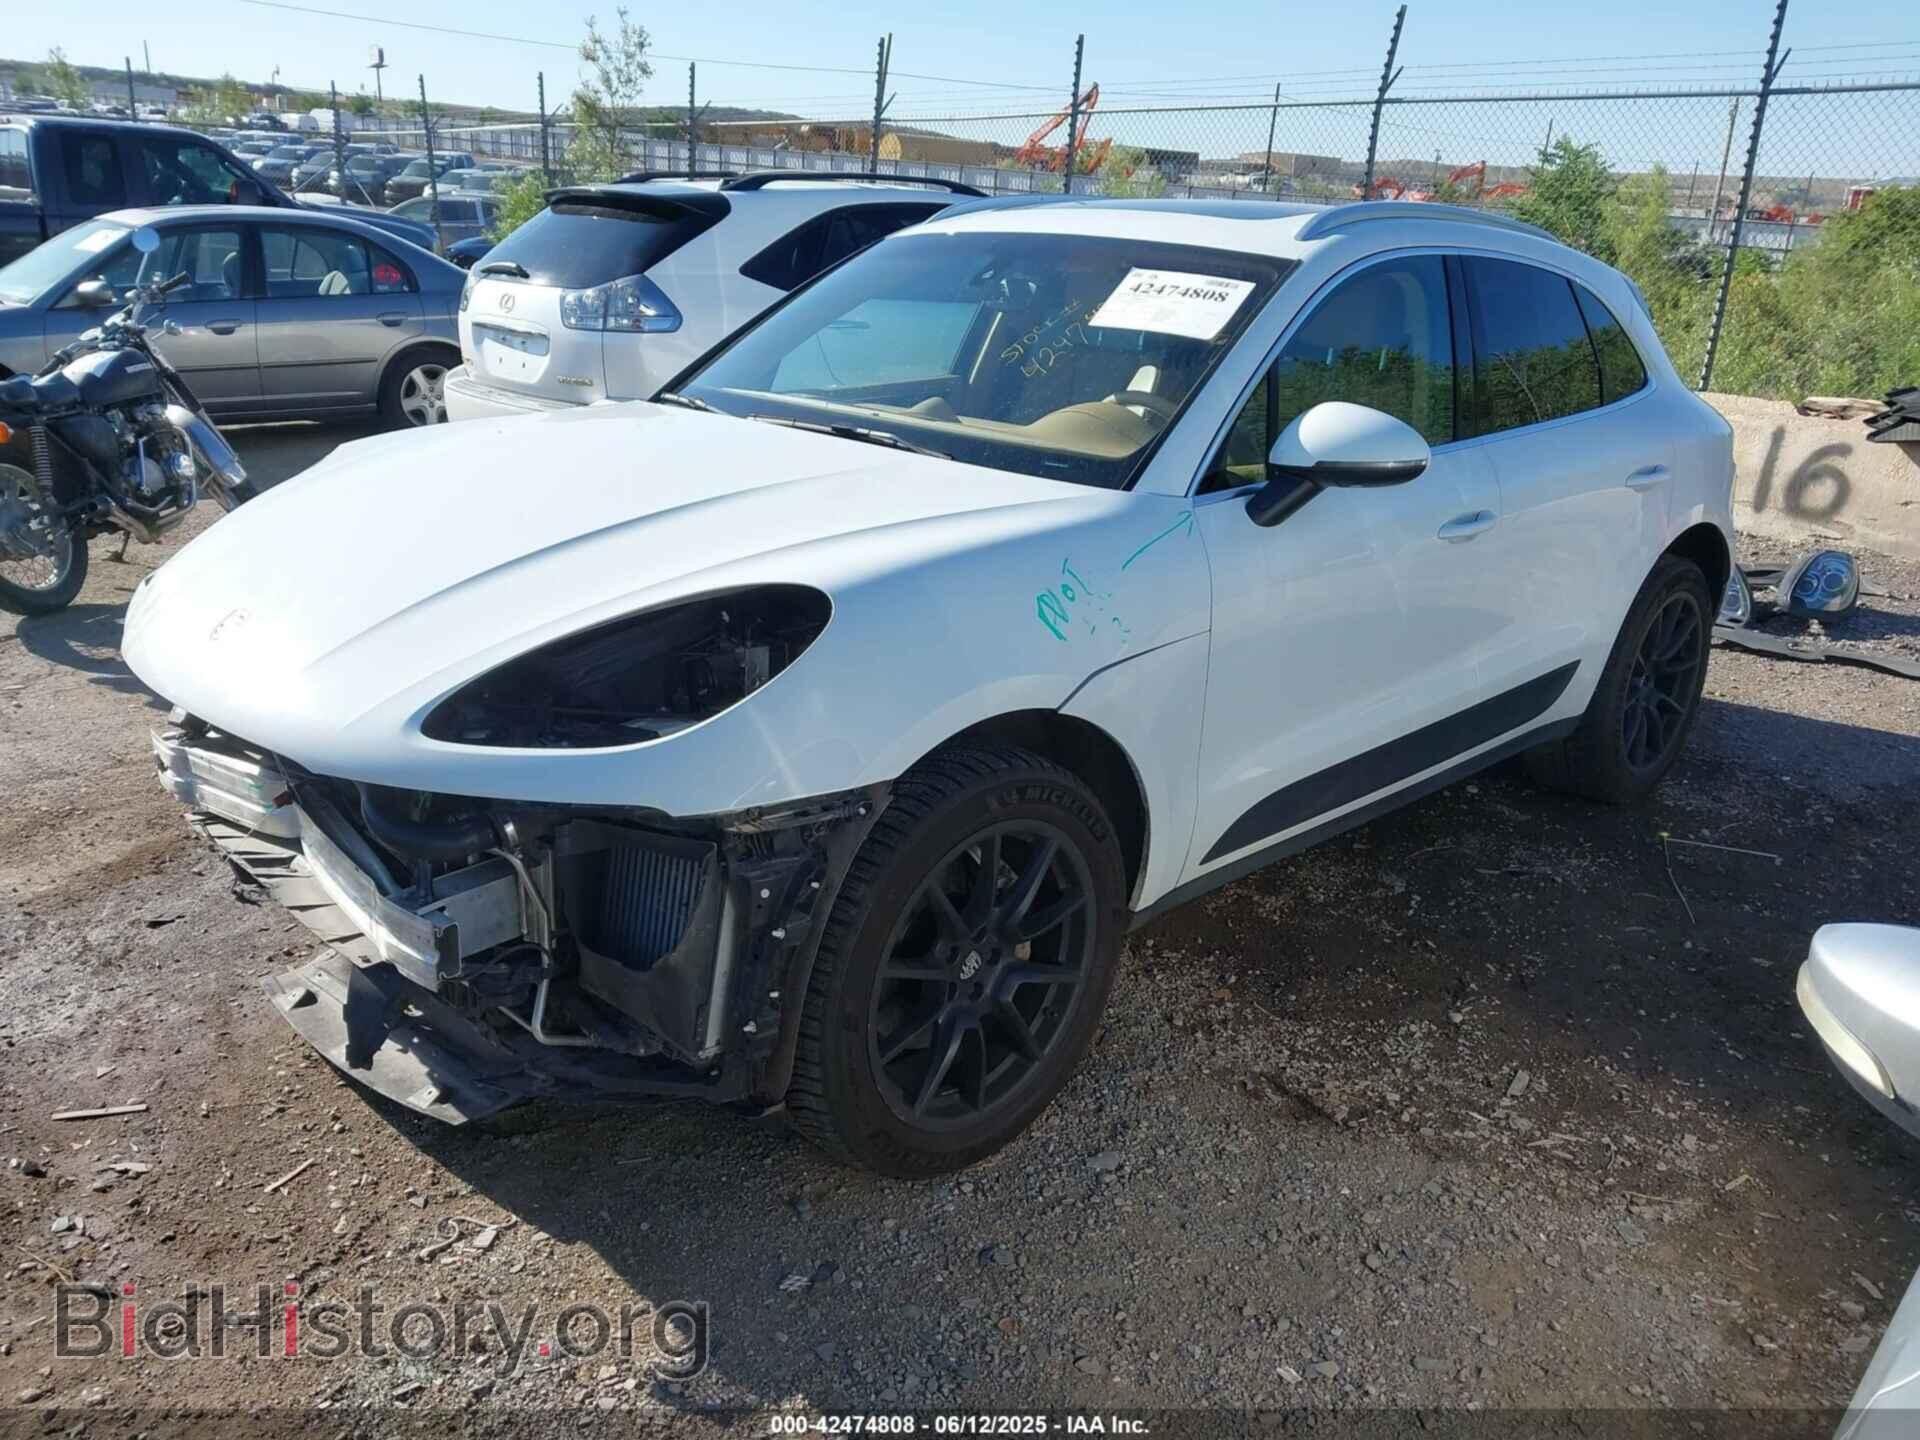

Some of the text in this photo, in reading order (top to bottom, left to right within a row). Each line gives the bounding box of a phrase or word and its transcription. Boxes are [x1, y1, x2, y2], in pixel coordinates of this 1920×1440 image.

[1129, 281, 1230, 303] 42474808
[1753, 414, 1853, 520] 16
[1023, 784, 1109, 842] MICHELIN
